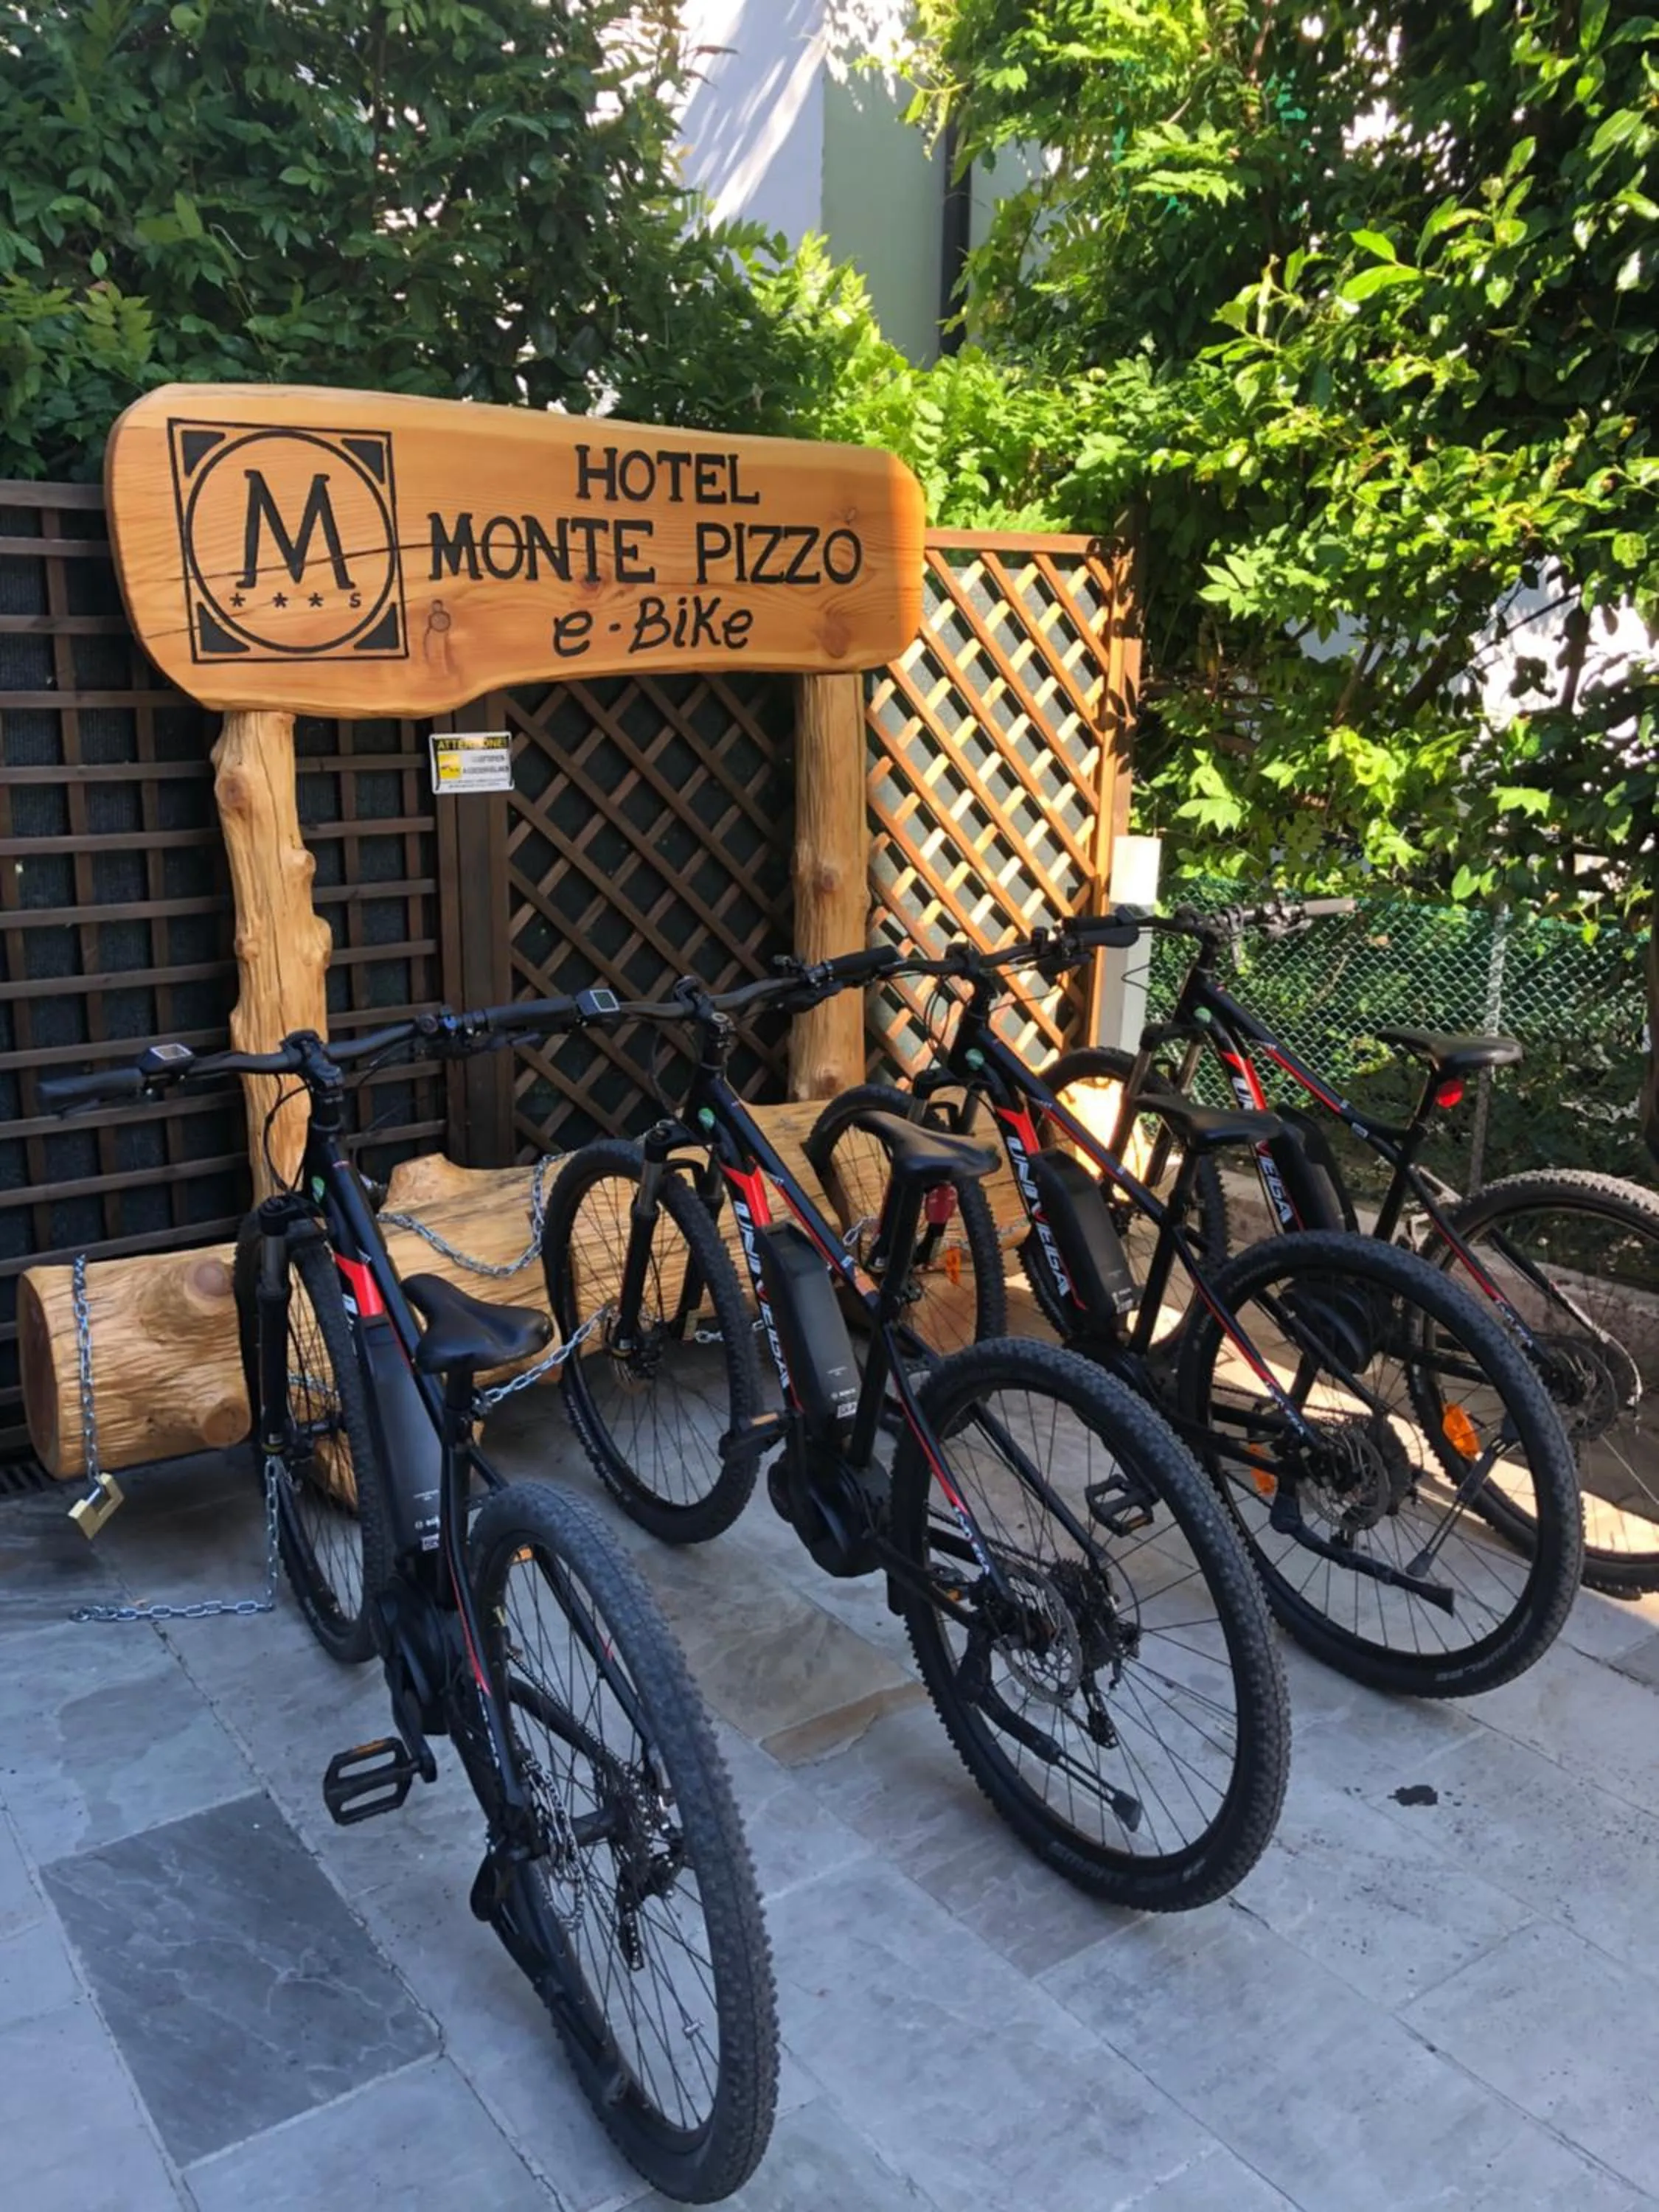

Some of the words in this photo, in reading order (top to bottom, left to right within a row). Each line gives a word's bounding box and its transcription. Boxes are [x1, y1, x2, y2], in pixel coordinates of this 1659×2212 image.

[574, 444, 760, 505] HOTEL
[236, 469, 356, 590] M
[427, 512, 655, 583] MONTE
[695, 521, 862, 585] PIZZO
[1006, 1135, 1073, 1297] UNIVEGA
